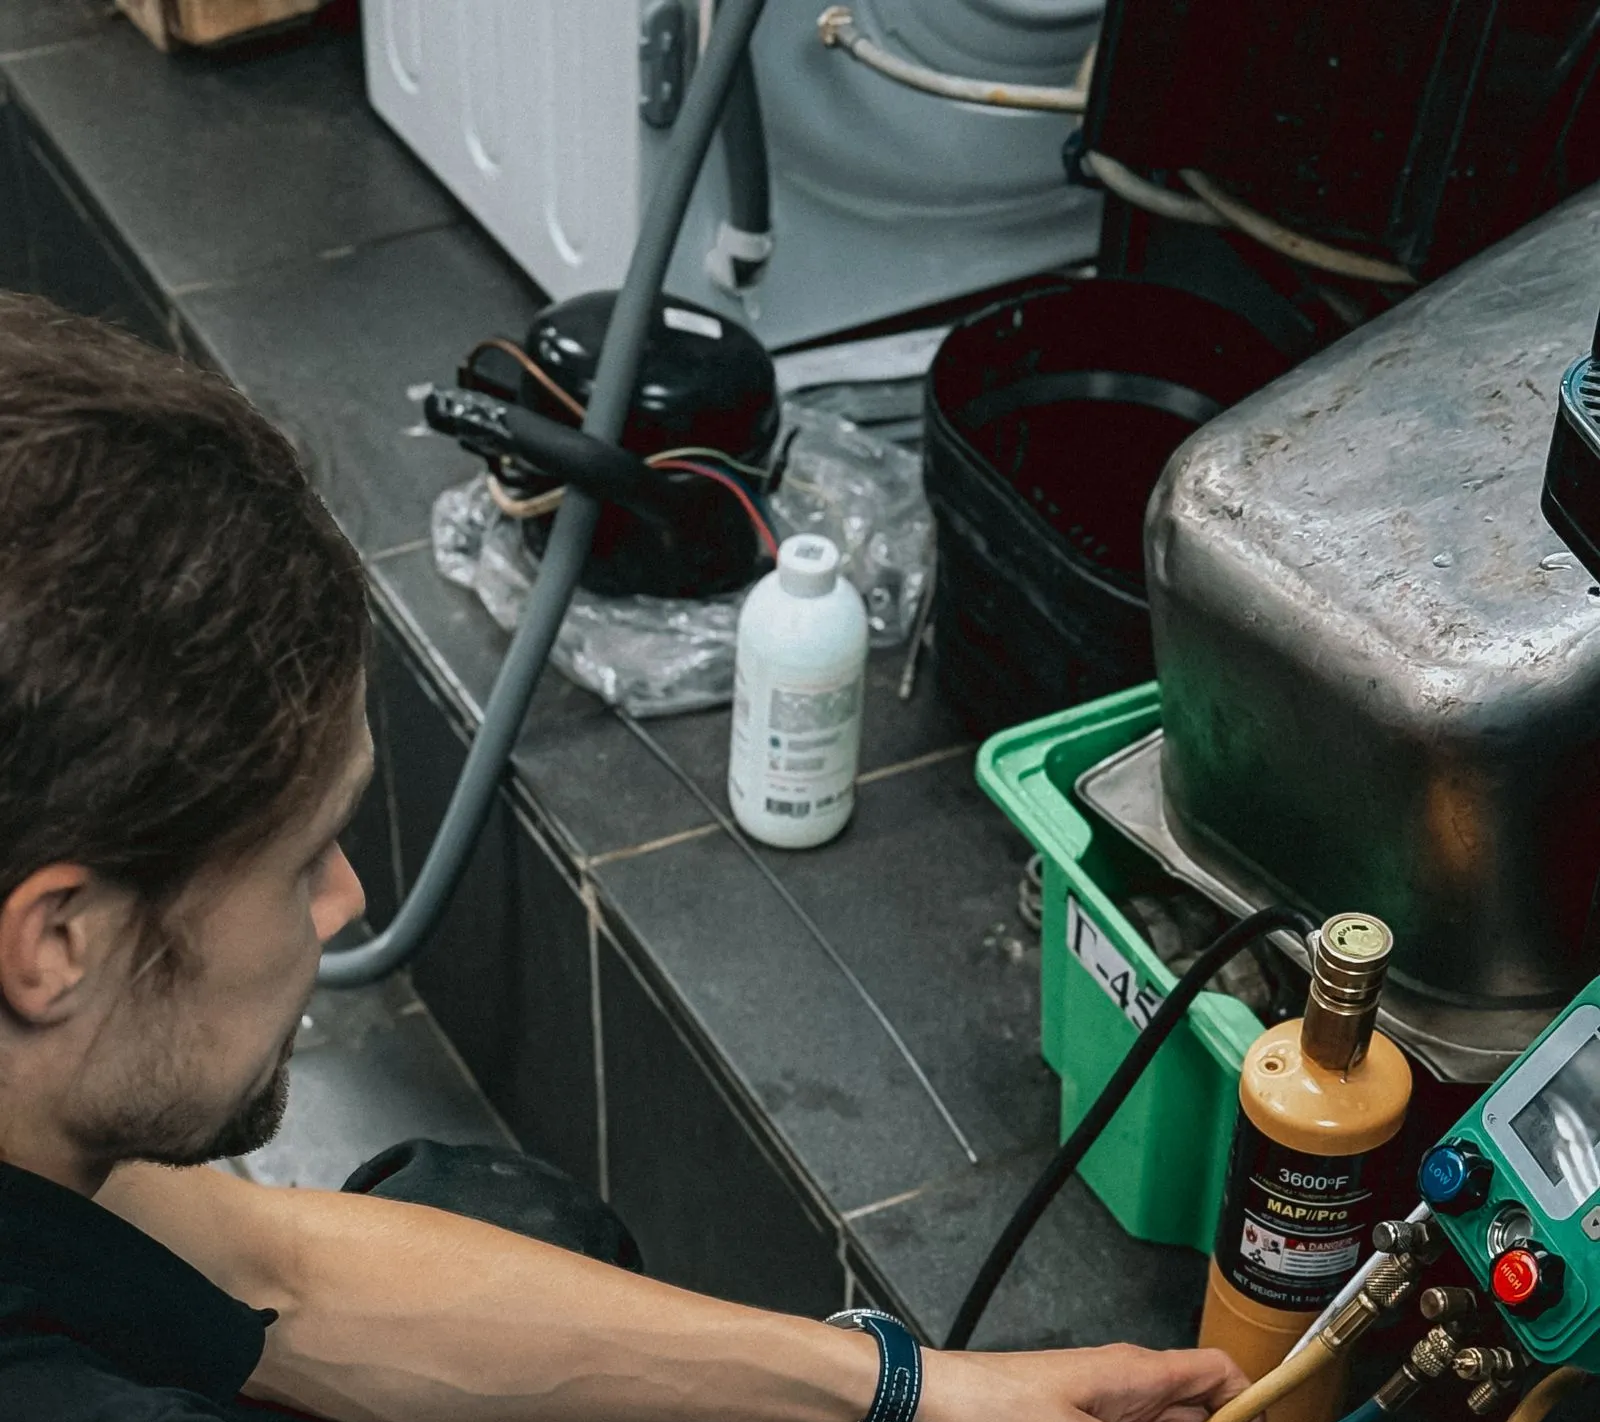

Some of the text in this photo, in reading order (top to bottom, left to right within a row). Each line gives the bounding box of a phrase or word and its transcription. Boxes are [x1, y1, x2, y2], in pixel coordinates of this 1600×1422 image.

[1428, 1162, 1452, 1186] LOW
[1266, 1198, 1348, 1221] MAP//Pro
[1500, 1262, 1523, 1290] HIGH
[1250, 1281, 1288, 1301] WEIGHT
